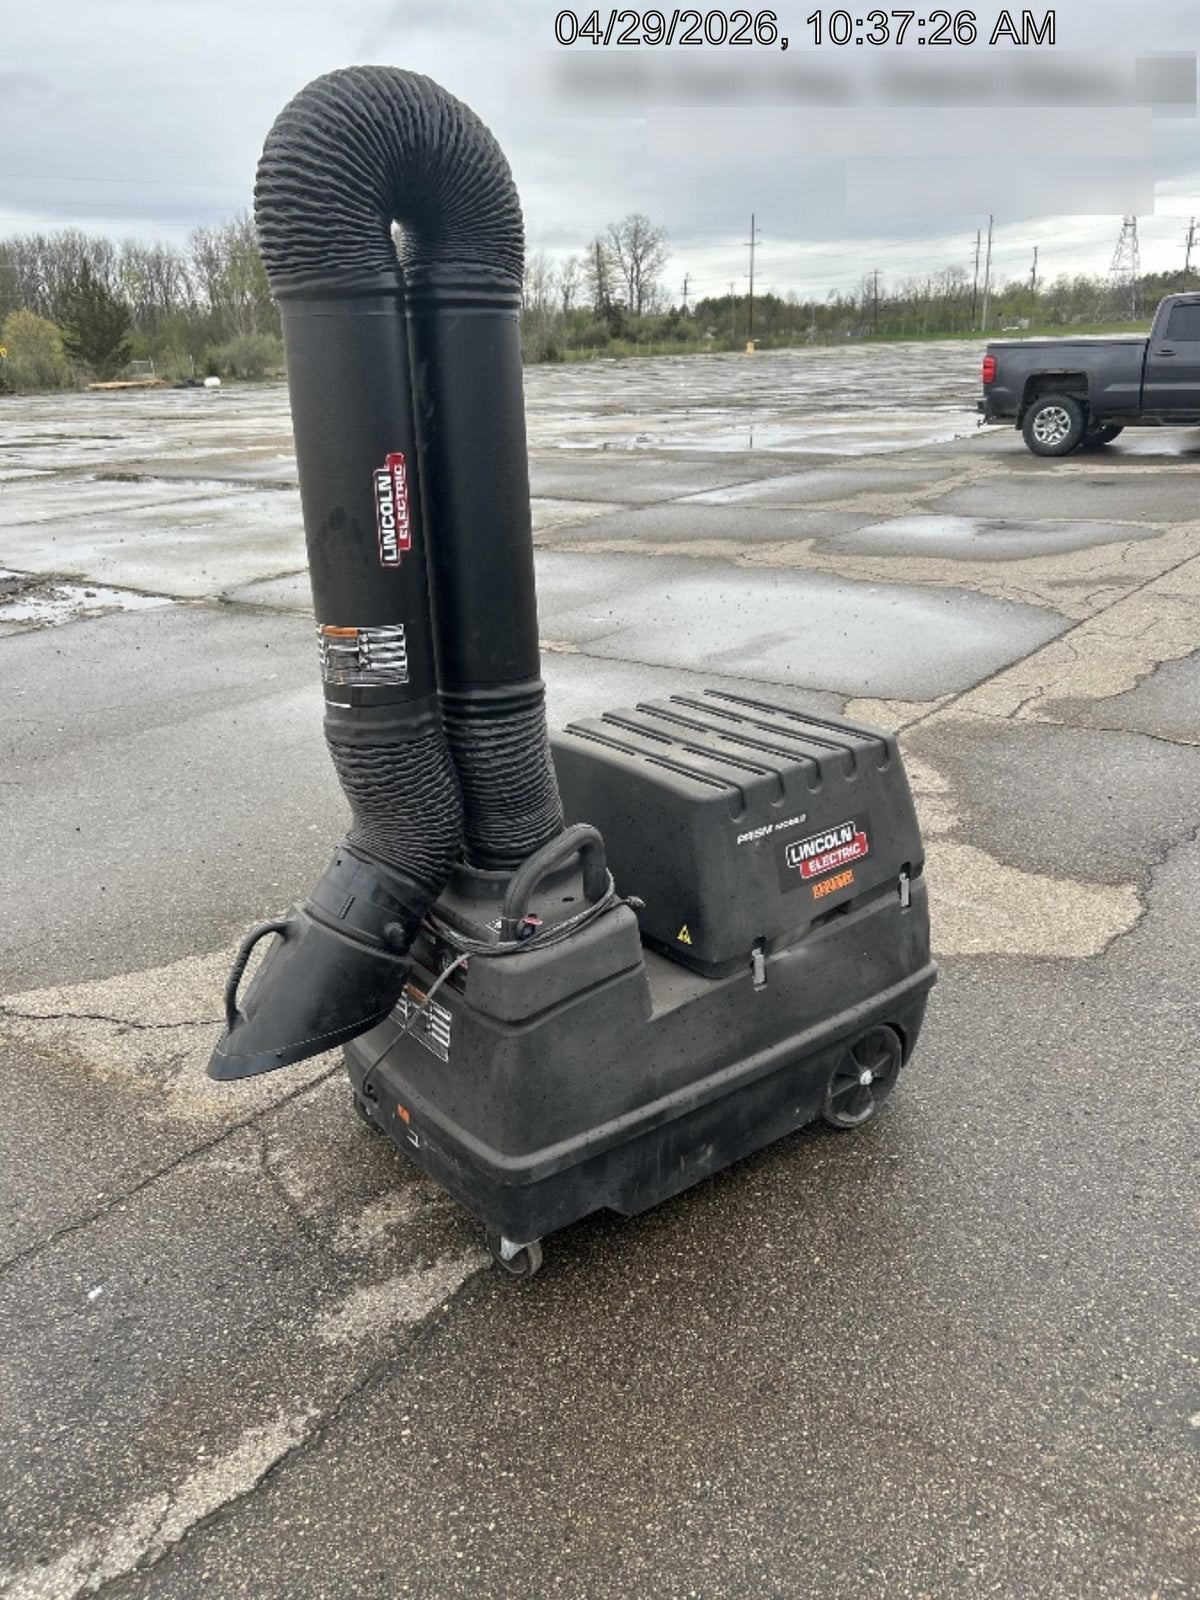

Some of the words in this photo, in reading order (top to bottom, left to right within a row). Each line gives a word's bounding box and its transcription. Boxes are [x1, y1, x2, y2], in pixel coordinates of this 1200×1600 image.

[378, 475, 398, 561] LINCOLN
[394, 463, 409, 540] ELECTRIC
[790, 826, 853, 863] LINCOLN
[808, 842, 861, 872] ELECTRIC
